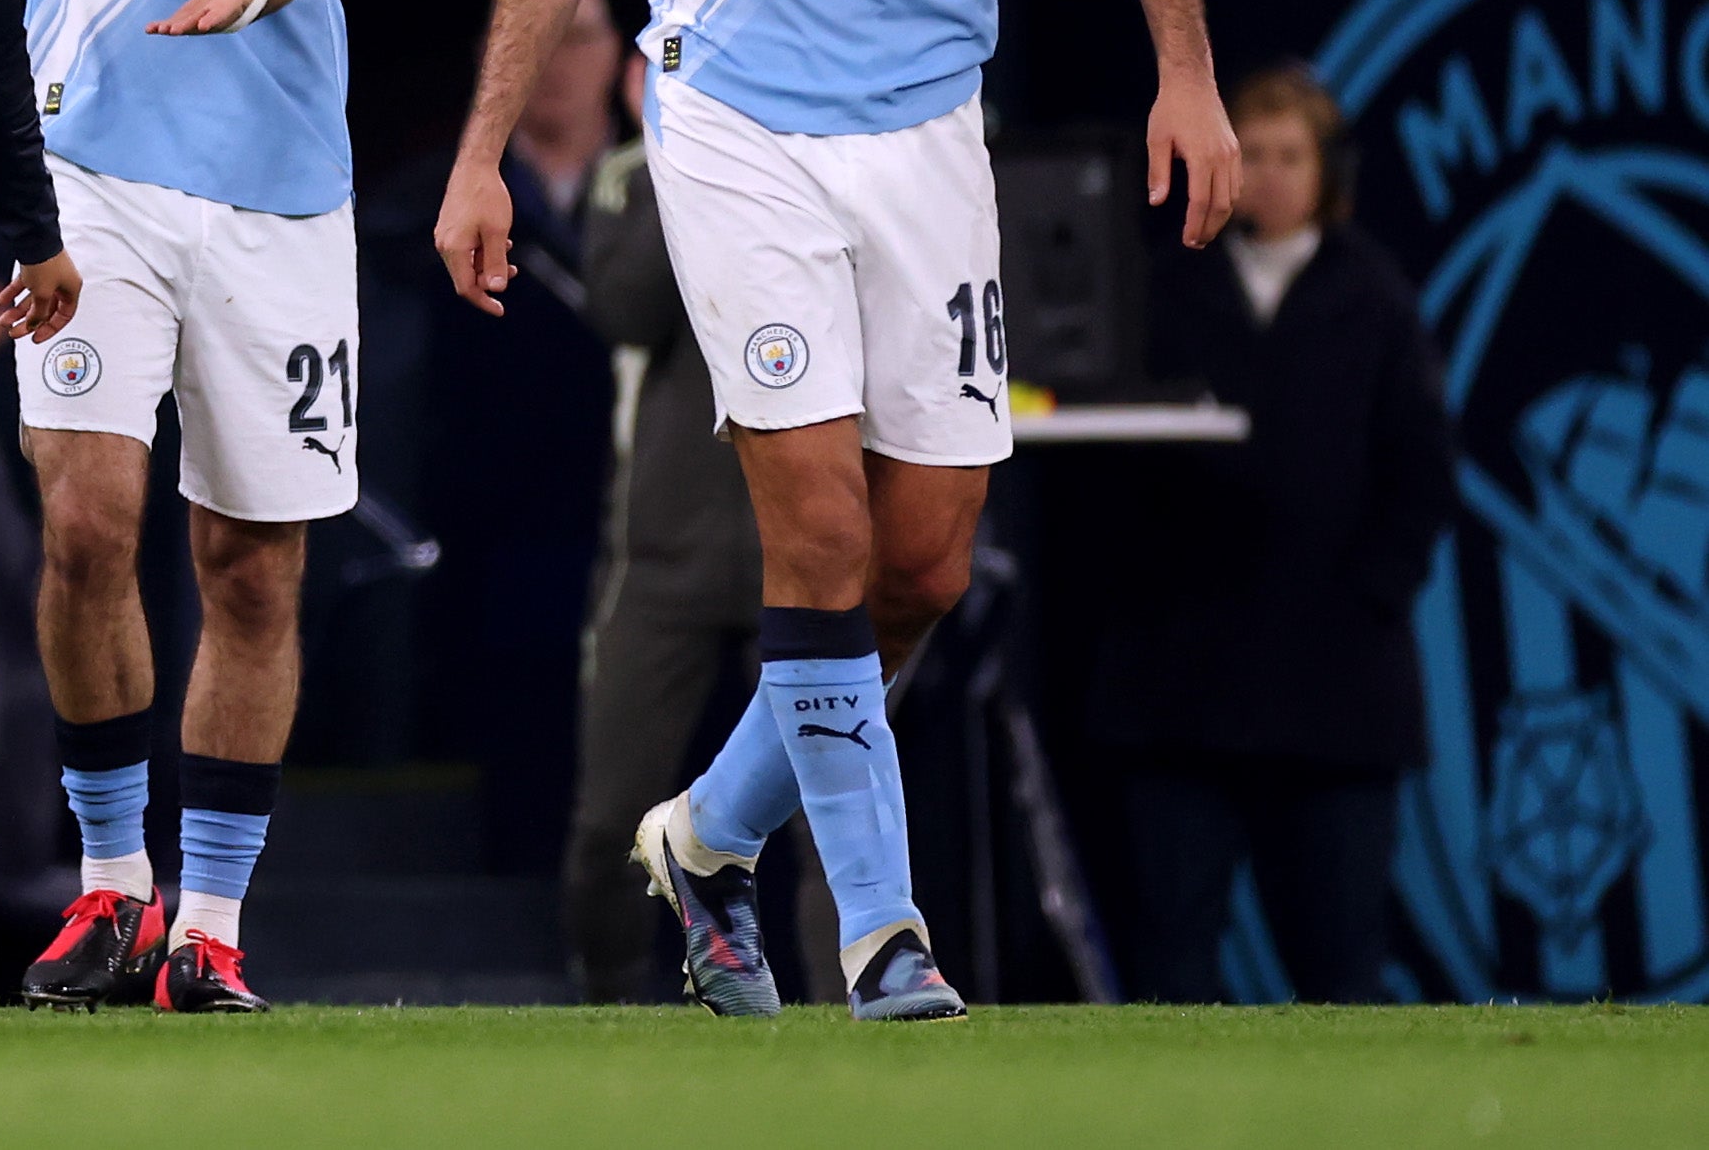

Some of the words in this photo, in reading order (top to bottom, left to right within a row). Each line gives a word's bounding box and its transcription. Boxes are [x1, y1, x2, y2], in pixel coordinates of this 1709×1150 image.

[946, 278, 1005, 377] 16
[47, 342, 94, 364] MANCHESTER
[750, 328, 799, 354] MANCHESTER
[64, 385, 82, 393] CITY
[286, 338, 353, 433] 21
[774, 375, 793, 385] CITY
